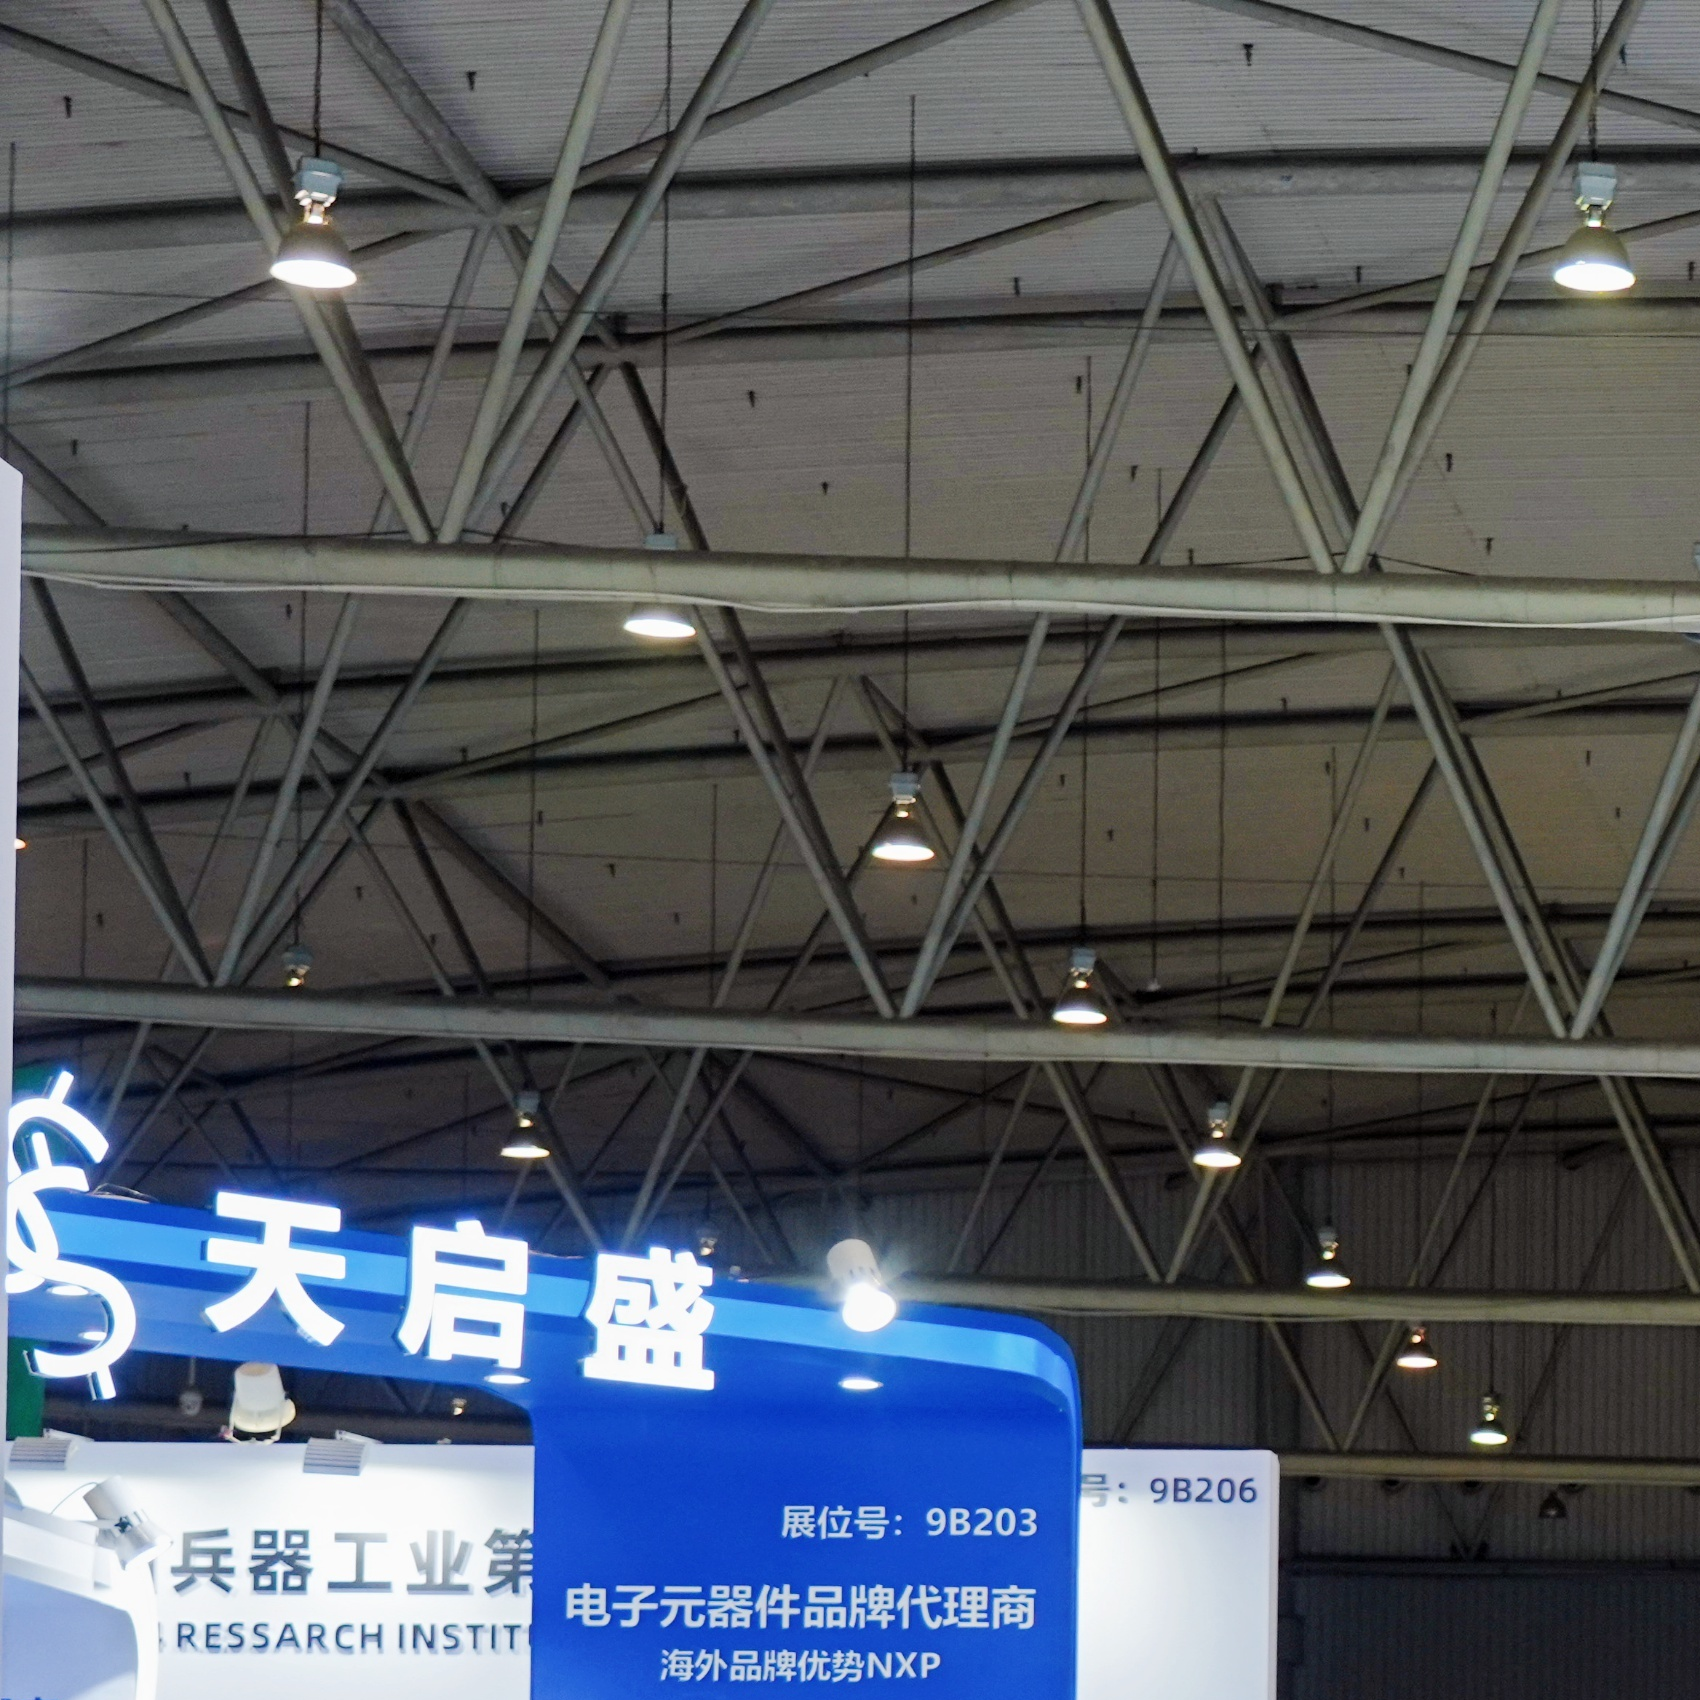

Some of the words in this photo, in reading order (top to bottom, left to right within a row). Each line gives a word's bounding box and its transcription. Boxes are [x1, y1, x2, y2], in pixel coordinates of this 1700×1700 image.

[204, 1191, 716, 1391] 天启盛
[564, 1583, 1037, 1631] 电子元器件品牌代理商
[399, 1622, 533, 1651] INSTIT
[660, 1650, 942, 1685] 海外品牌优势NXP
